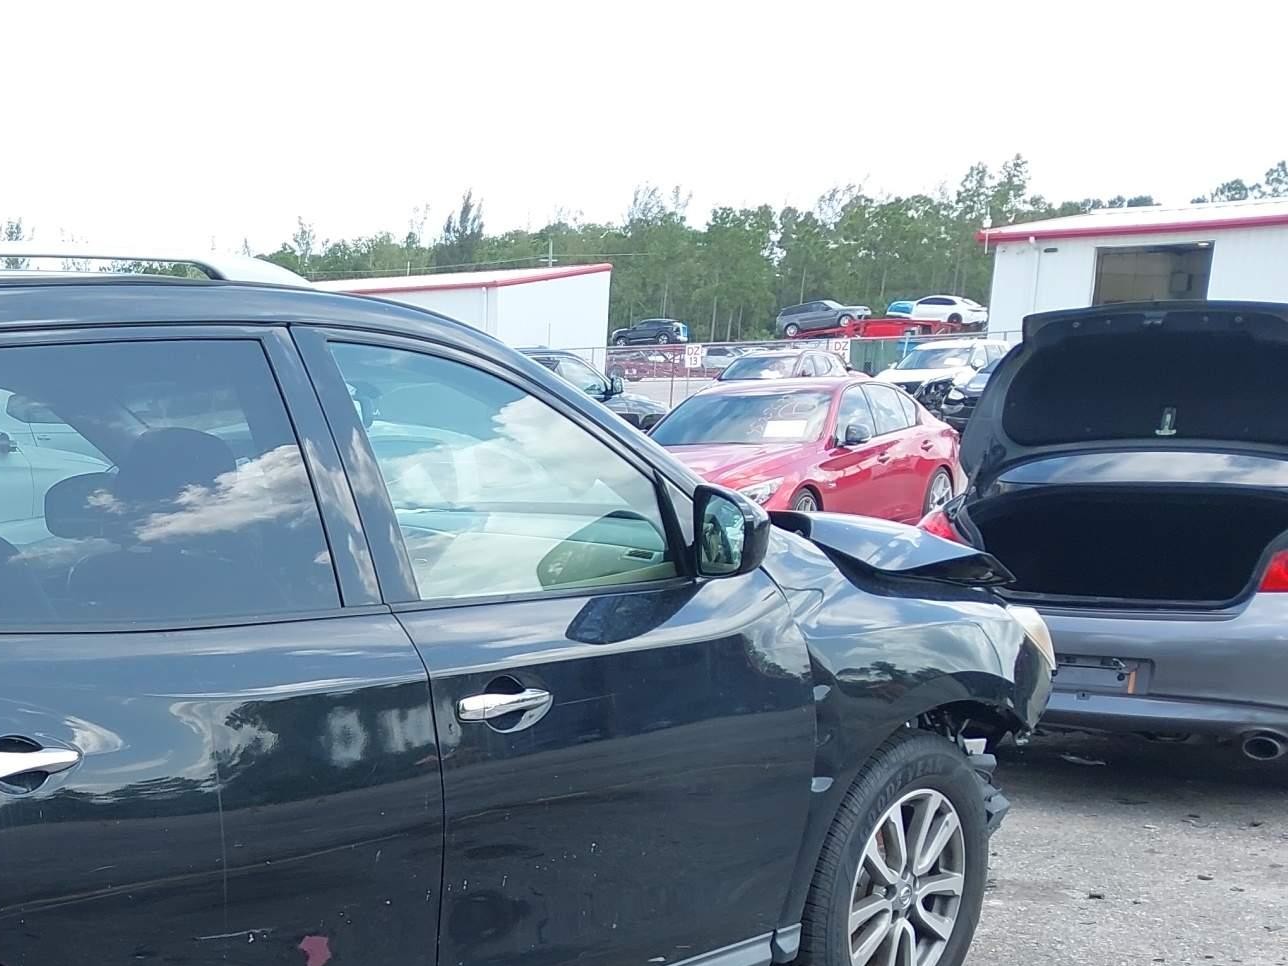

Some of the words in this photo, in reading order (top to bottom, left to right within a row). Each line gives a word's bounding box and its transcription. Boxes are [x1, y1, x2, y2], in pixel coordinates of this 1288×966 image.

[687, 346, 700, 356] DZ
[834, 341, 848, 351] DZ
[689, 356, 698, 366] 13
